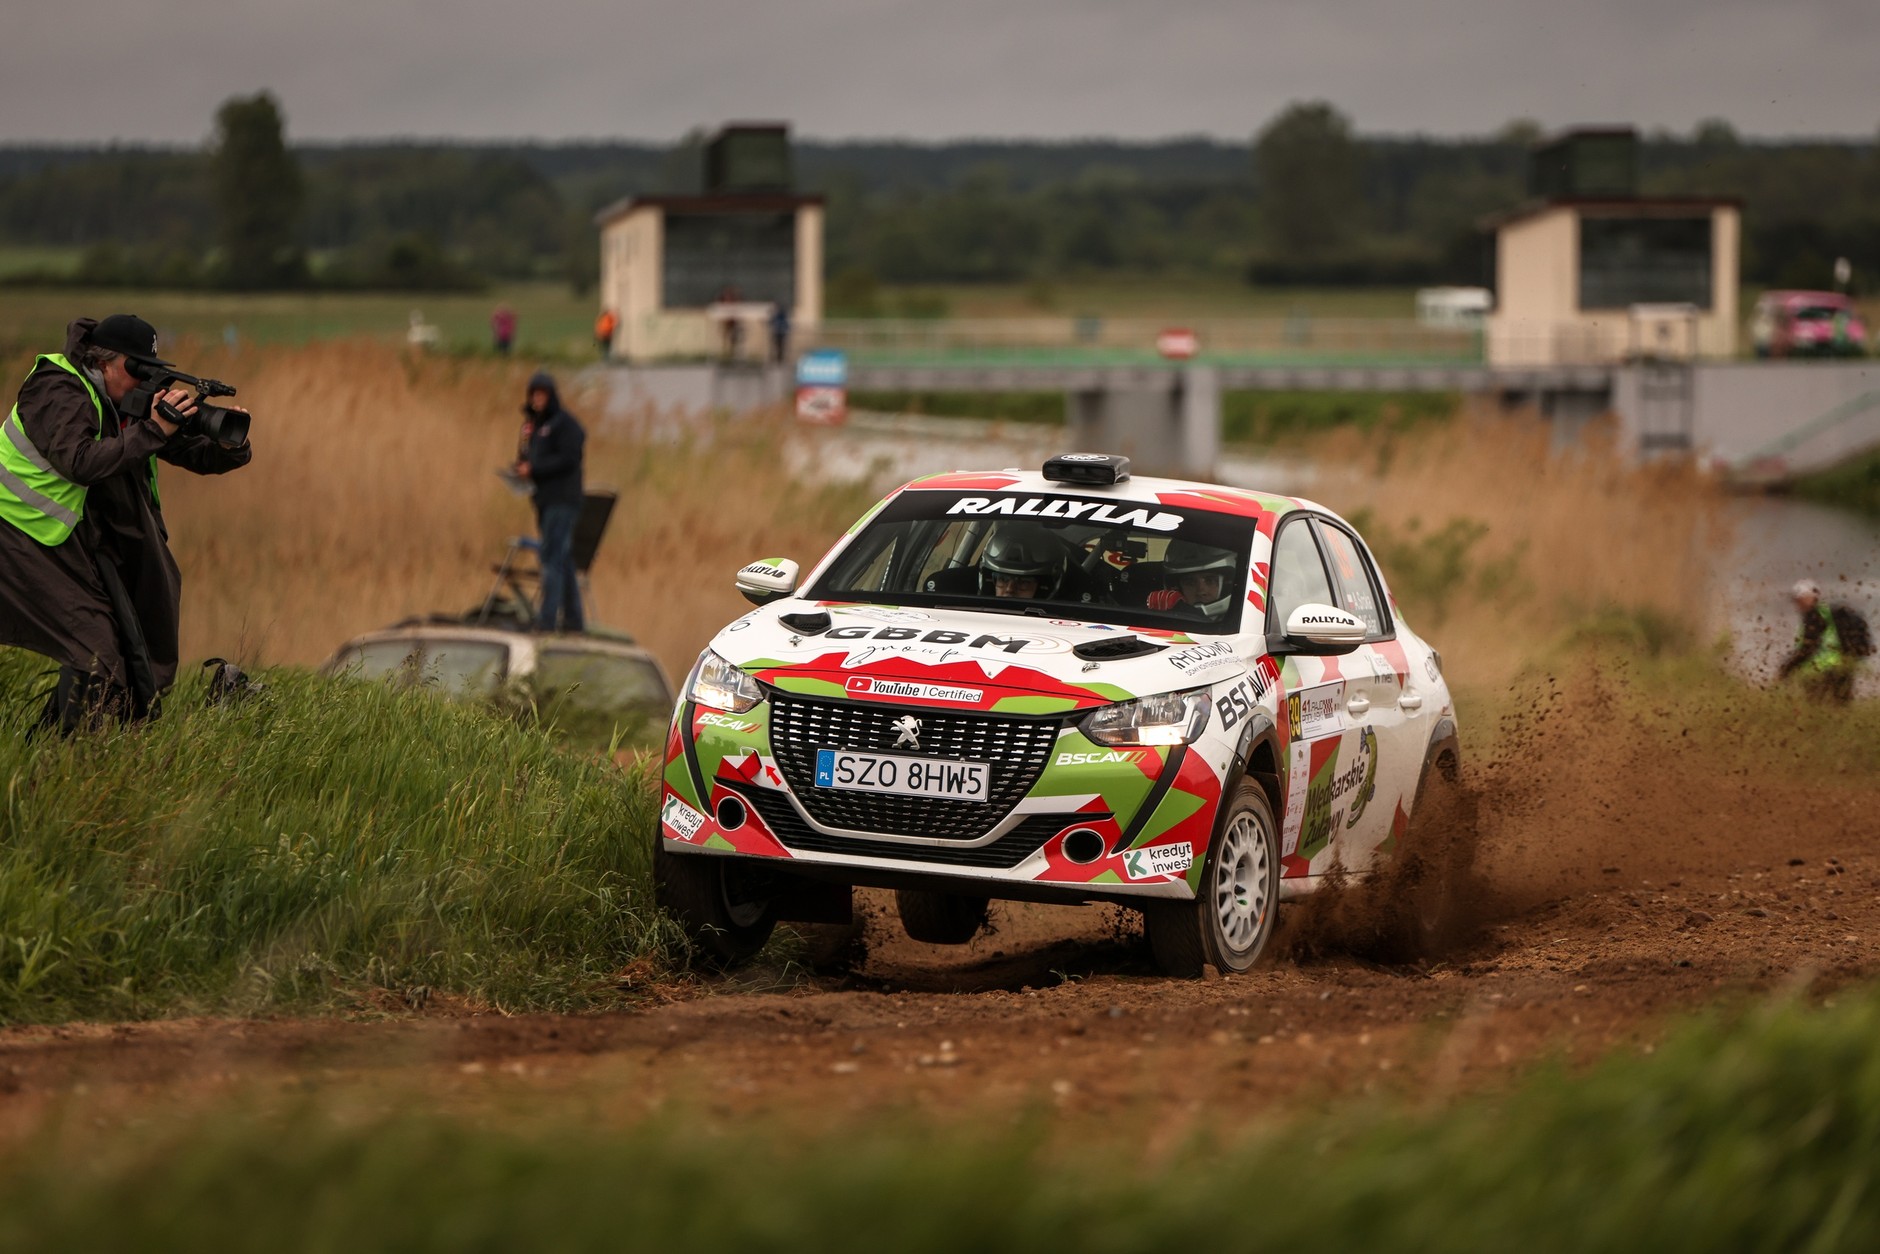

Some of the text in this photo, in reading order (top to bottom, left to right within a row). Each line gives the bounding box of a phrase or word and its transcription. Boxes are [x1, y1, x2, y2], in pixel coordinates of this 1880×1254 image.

[946, 497, 1184, 531] RALLYLAB
[1302, 616, 1355, 626] RALLYLAB
[825, 626, 1030, 654] GBBM
[846, 644, 964, 666] group
[872, 680, 983, 702] YouTube Certified
[1216, 670, 1265, 732] BSCAV
[696, 713, 753, 731] BSCAV
[1289, 697, 1301, 737] 39
[1056, 751, 1130, 766] BSCAV
[819, 771, 830, 781] PL
[847, 755, 984, 796] SZO 8HW5
[678, 803, 703, 828] kredyt
[671, 815, 694, 839] inwest
[1149, 843, 1191, 860] kredyt
[1153, 858, 1191, 873] inwest
